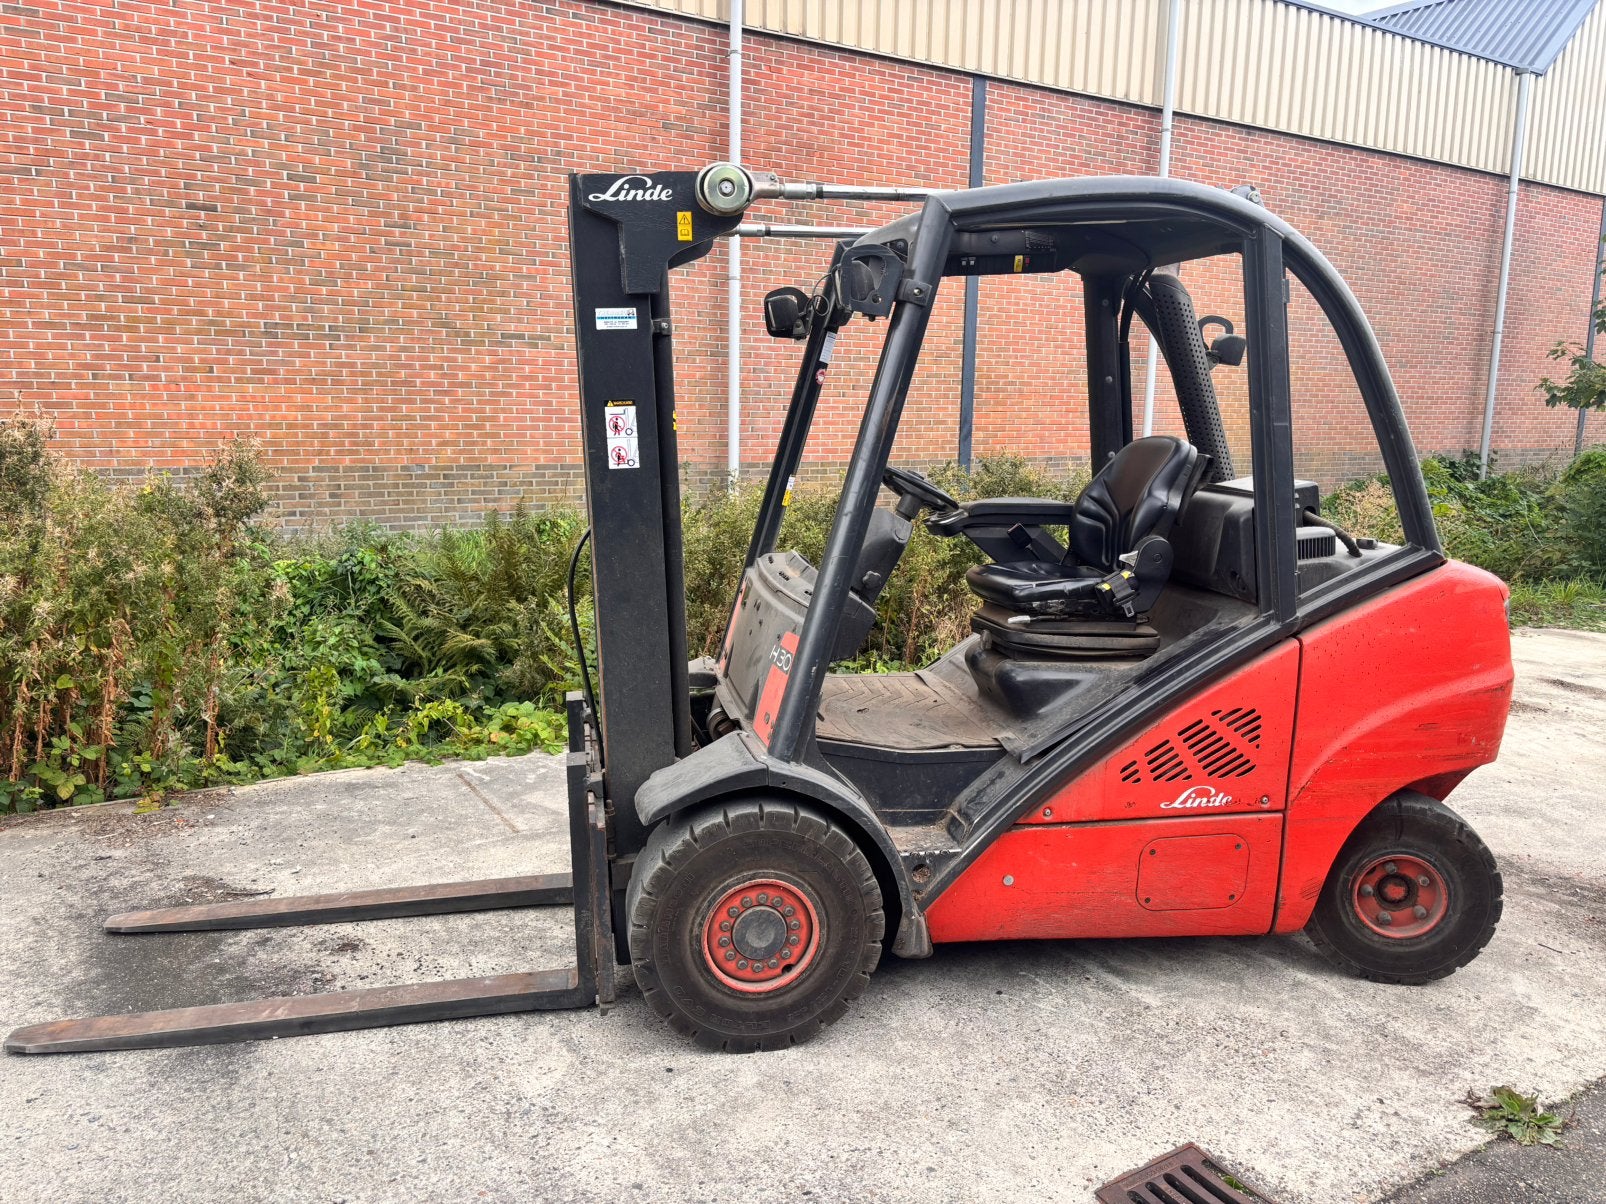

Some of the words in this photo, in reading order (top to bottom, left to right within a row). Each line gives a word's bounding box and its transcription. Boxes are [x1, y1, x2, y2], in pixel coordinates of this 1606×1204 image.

[588, 175, 673, 201] Linde
[769, 645, 792, 671] H30
[1160, 786, 1232, 808] Linde
